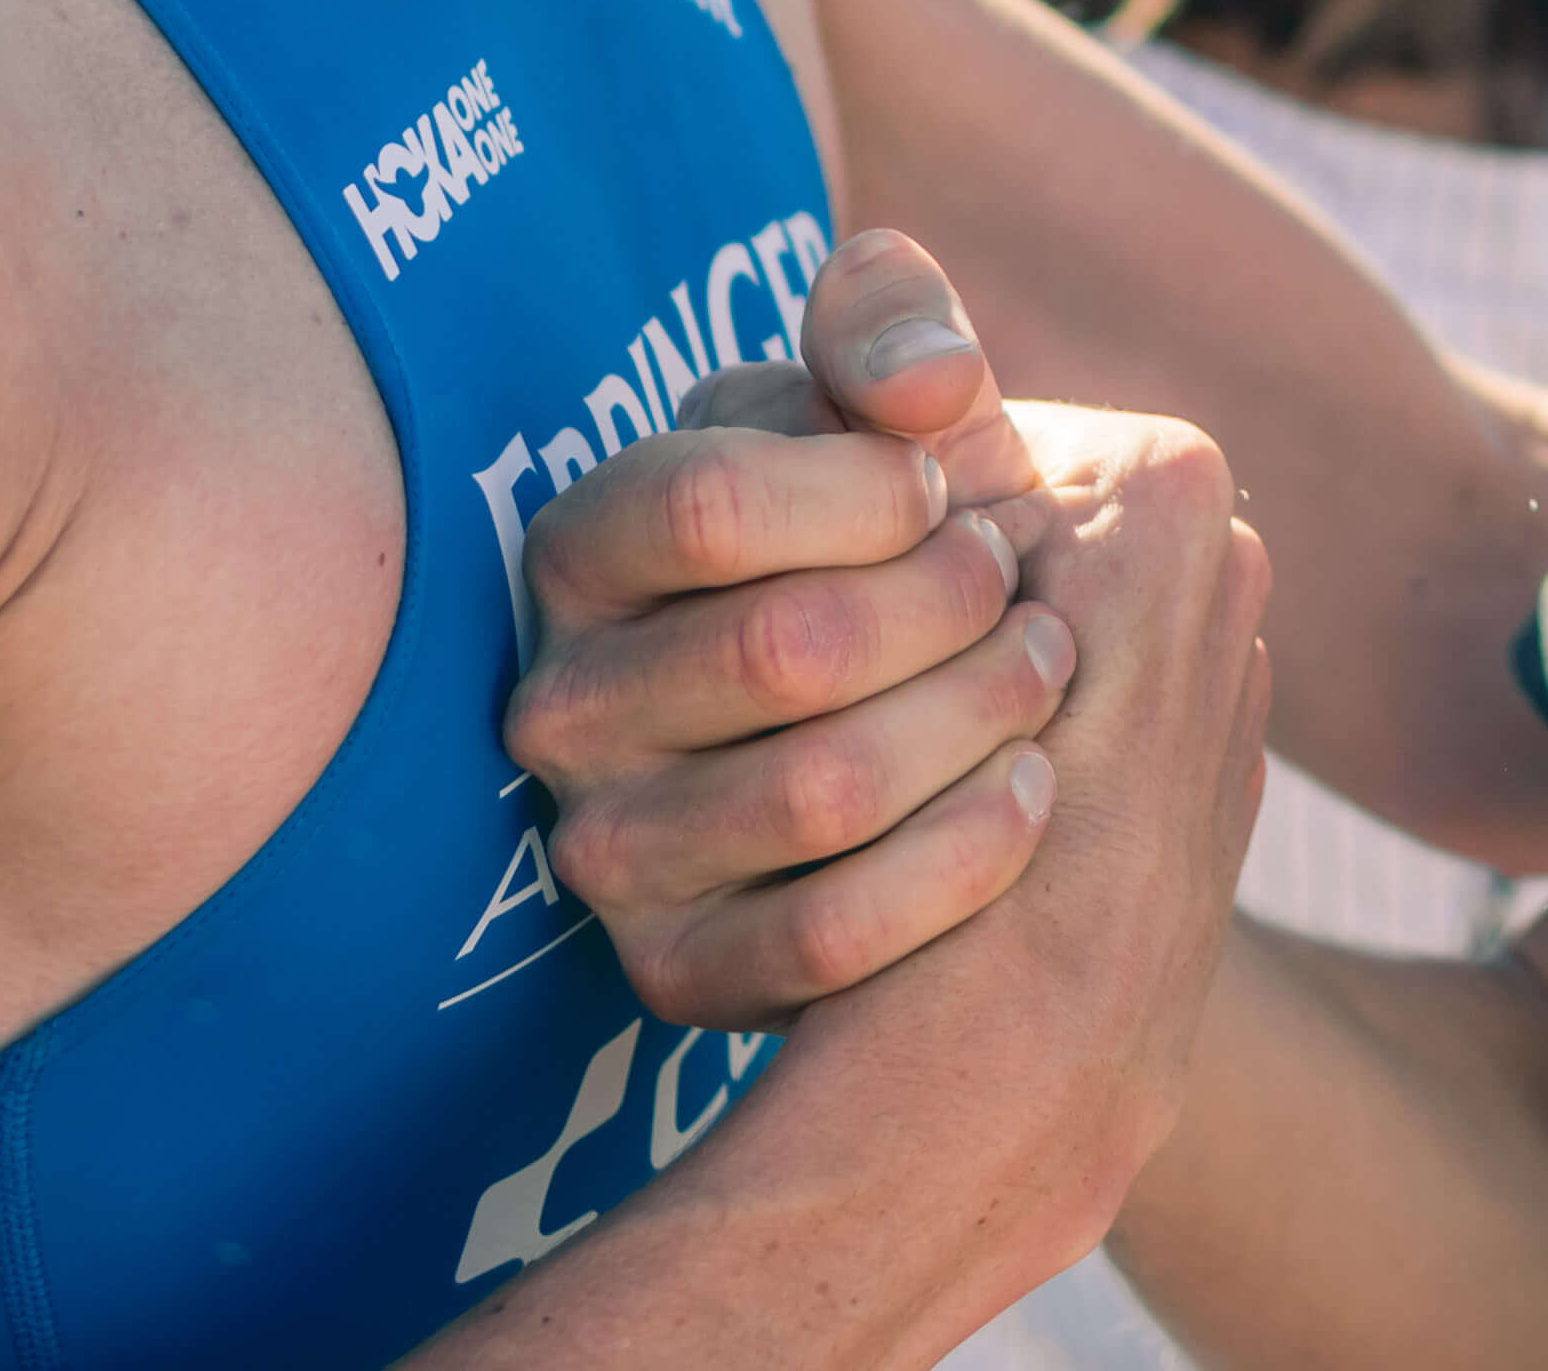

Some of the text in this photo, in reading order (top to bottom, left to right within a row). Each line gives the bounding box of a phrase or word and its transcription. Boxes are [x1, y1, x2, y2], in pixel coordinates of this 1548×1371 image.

[342, 58, 524, 281] HOKA ONE ONE
